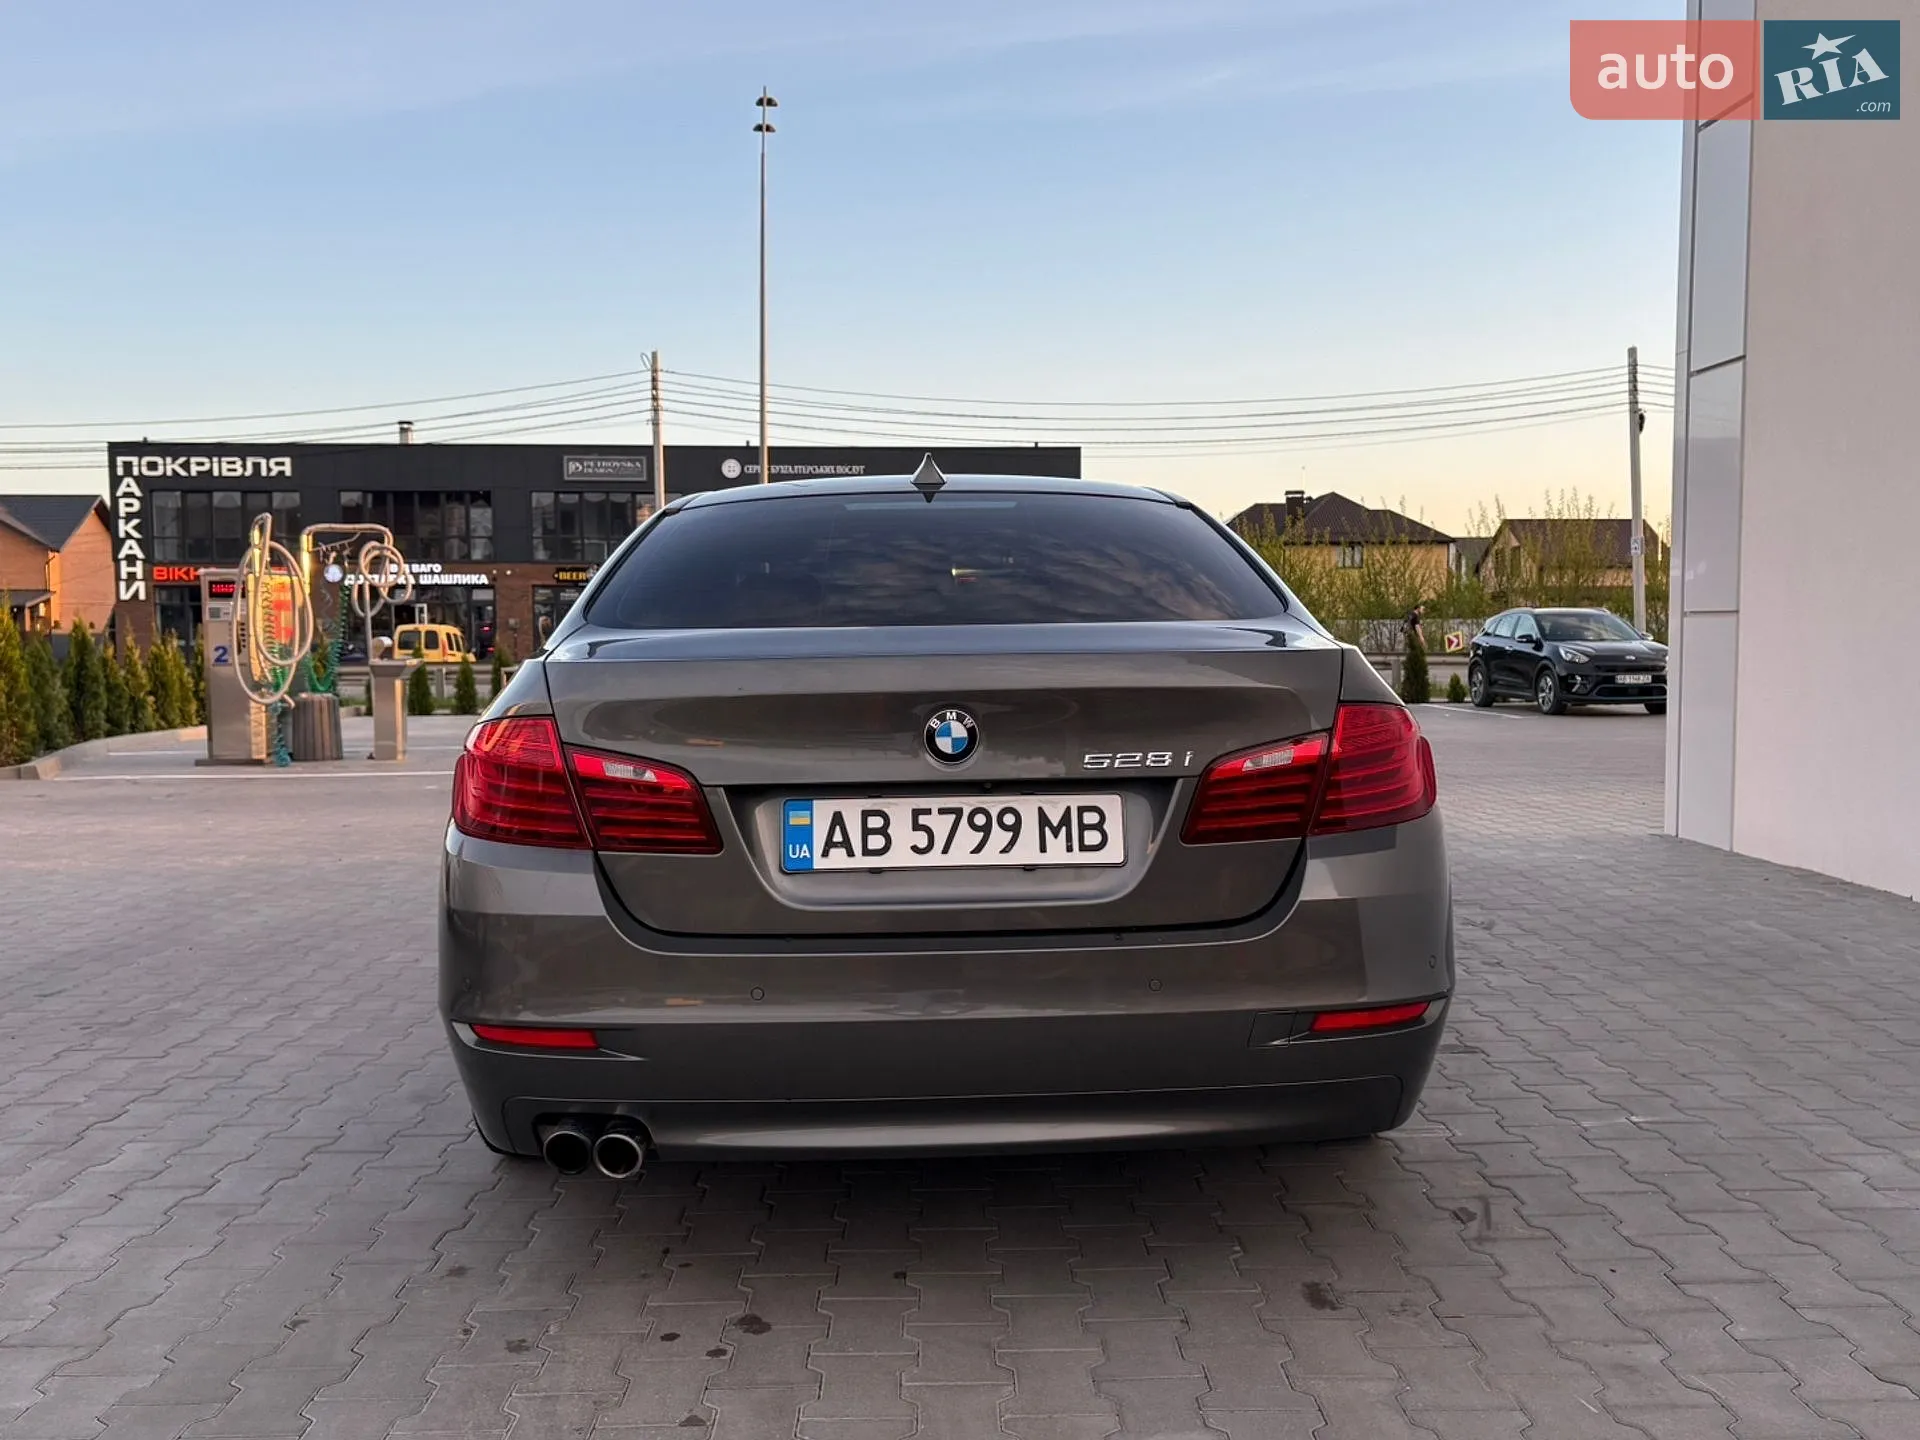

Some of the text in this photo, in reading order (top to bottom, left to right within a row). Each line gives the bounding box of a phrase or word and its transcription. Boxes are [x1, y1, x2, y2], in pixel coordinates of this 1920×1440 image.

[116, 456, 292, 477] ПОКРІВЛЯ
[411, 563, 442, 574] ВАГО
[419, 574, 489, 585] ШАШЛИКА
[213, 645, 229, 663] 2
[930, 711, 974, 729] BMW
[820, 805, 1109, 859] AB 5799 MB
[788, 845, 811, 859] UA
